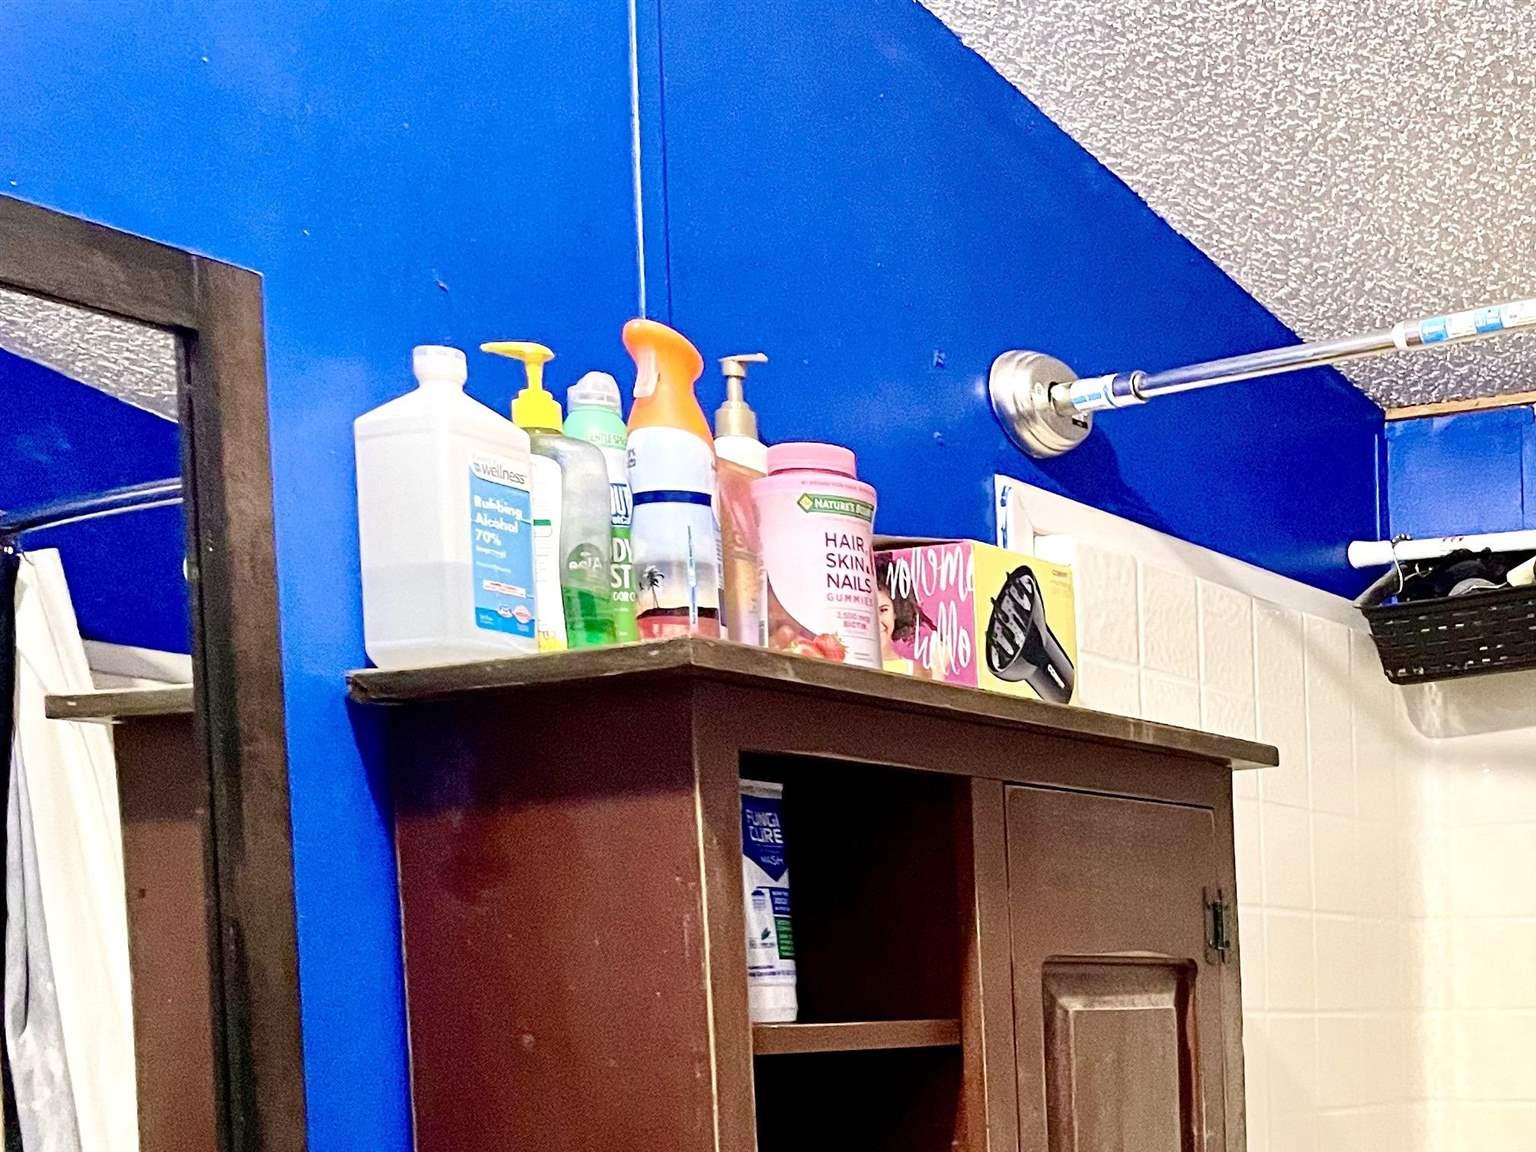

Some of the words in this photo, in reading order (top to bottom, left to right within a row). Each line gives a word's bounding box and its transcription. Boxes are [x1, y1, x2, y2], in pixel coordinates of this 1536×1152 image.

[482, 464, 525, 484] wellness
[474, 495, 523, 521] Rubbing
[475, 512, 519, 533] Alcohol
[827, 573, 872, 593] NAILS
